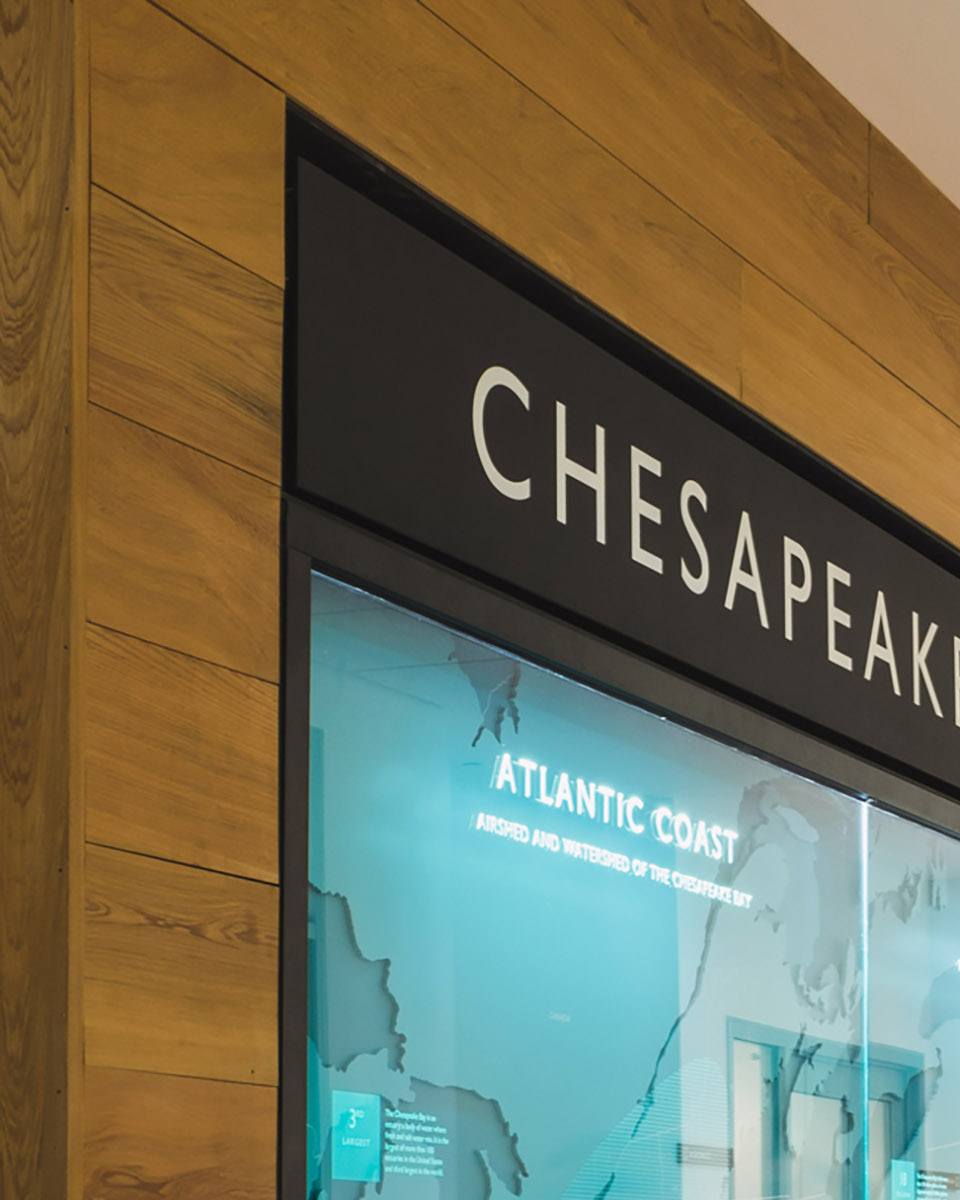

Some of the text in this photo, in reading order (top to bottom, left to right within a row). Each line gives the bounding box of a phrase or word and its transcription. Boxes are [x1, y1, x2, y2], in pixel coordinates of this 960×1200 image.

[493, 753, 739, 865] ATLANTIC COAST
[475, 811, 530, 844] AIRSHED
[531, 828, 561, 852] AND
[562, 837, 631, 874] WATERSHED
[632, 858, 649, 877] OF
[649, 863, 671, 885] THE
[341, 1136, 371, 1148] LARGEST
